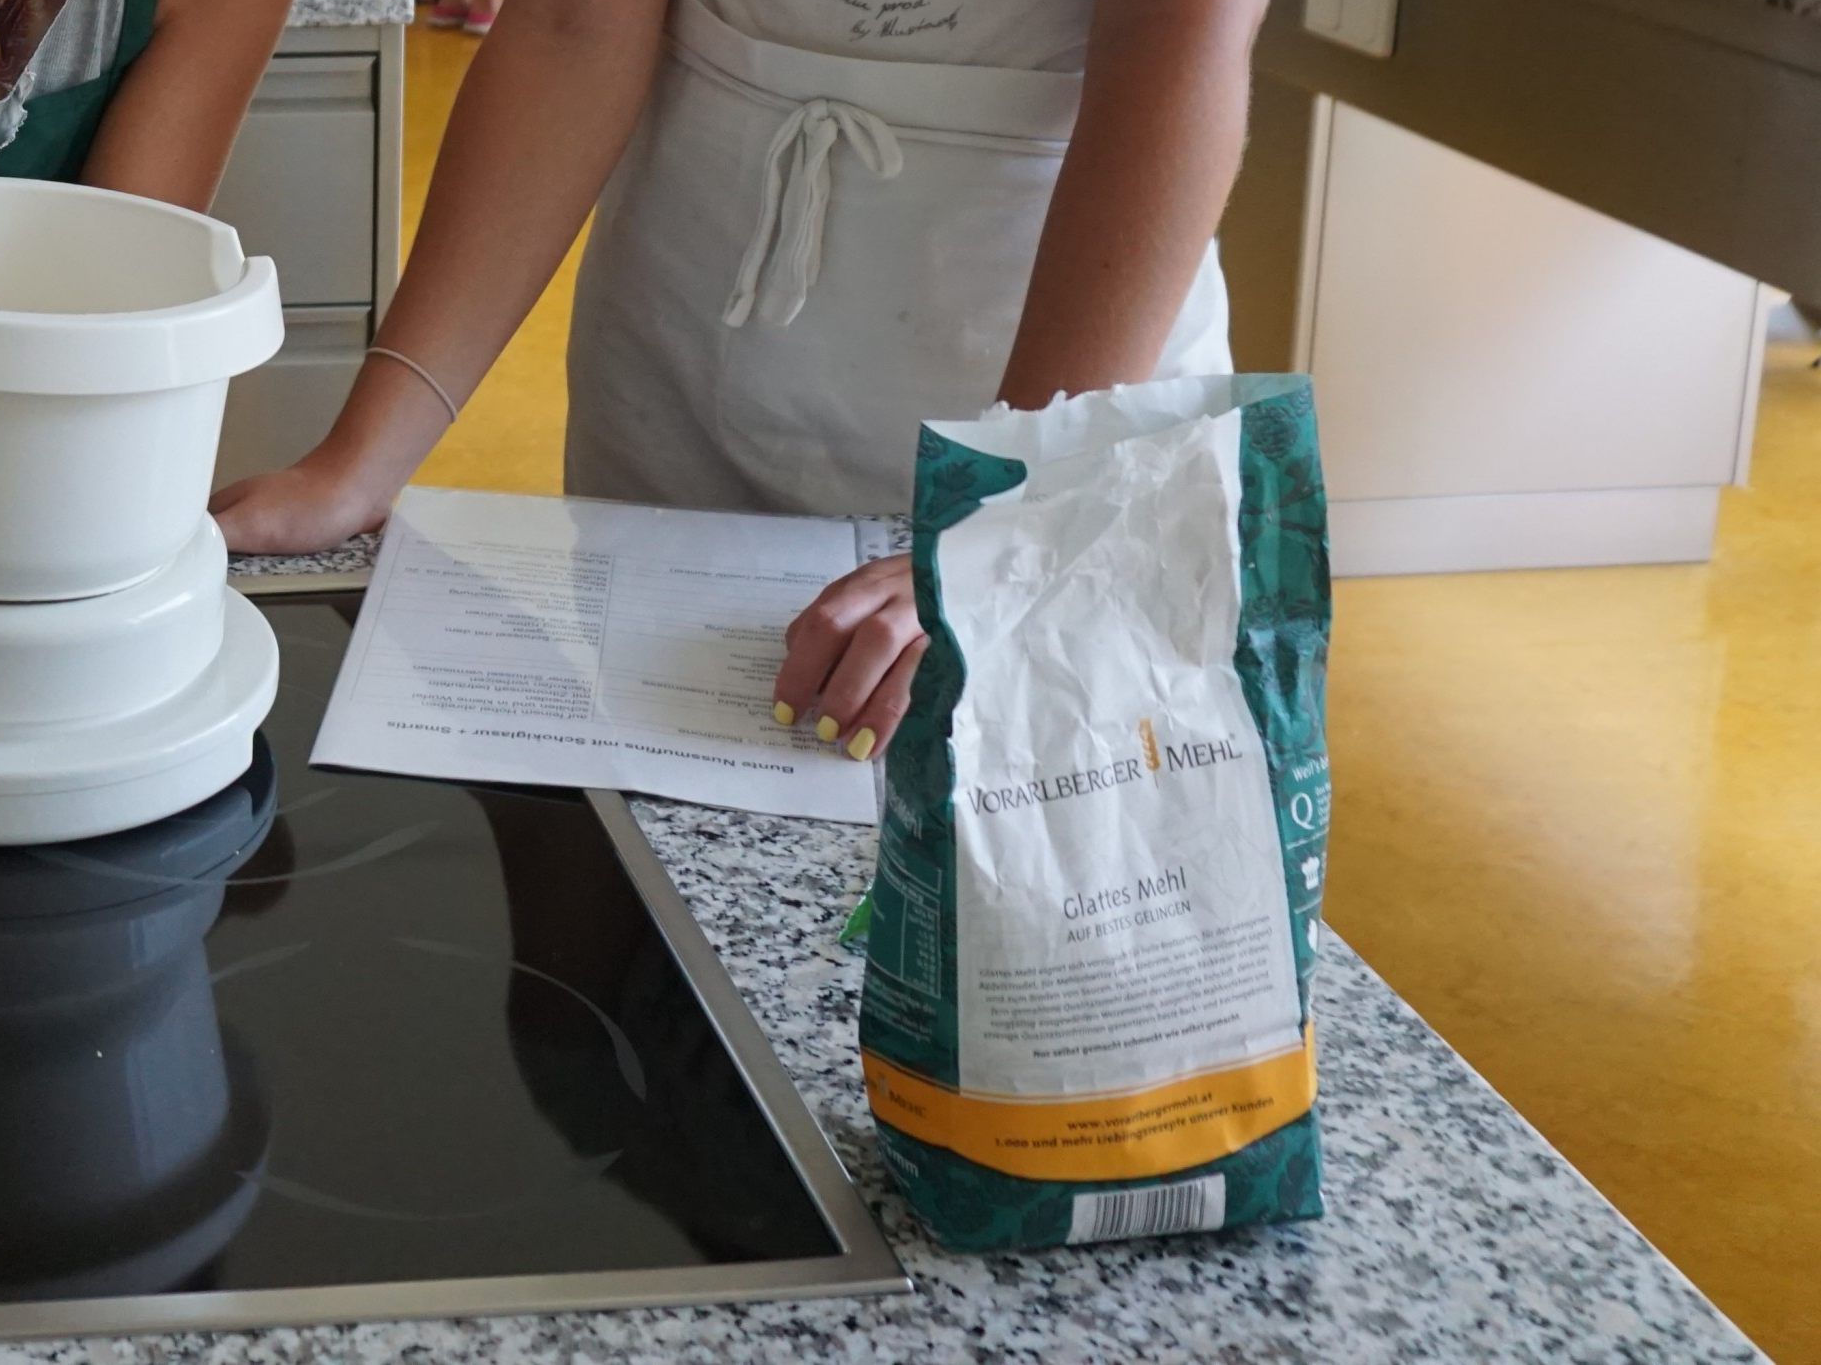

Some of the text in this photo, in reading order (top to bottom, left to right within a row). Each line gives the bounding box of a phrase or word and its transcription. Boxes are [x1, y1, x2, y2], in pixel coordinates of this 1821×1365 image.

[387, 721, 451, 734] Smartis
[471, 727, 585, 745] Schokiglasur
[592, 739, 617, 747] mit
[624, 742, 734, 766] Nussmuffins
[742, 761, 793, 774] Bunte
[966, 757, 1143, 815] VORARLBERGER
[1165, 737, 1243, 772] MEHL
[1063, 865, 1188, 921] Glattes Mehl
[1066, 899, 1192, 944] AUF BESTES GELINGEN
[1033, 1047, 1049, 1058] Nur
[1052, 1044, 1078, 1057] selbst
[1082, 1038, 1120, 1055] gemacht
[1123, 1028, 1162, 1049] schmeckt
[1164, 1028, 1178, 1039] wie
[1181, 1021, 1204, 1036] selbst
[1032, 1137, 1058, 1148] und
[1061, 1136, 1094, 1148] mehr
[1096, 1117, 1187, 1146] Lieblingsrezepte
[1189, 1107, 1230, 1125] unserer
[1231, 1096, 1275, 1115] Kunden
[1066, 1091, 1213, 1131] www.vorarlbergermehl.at
